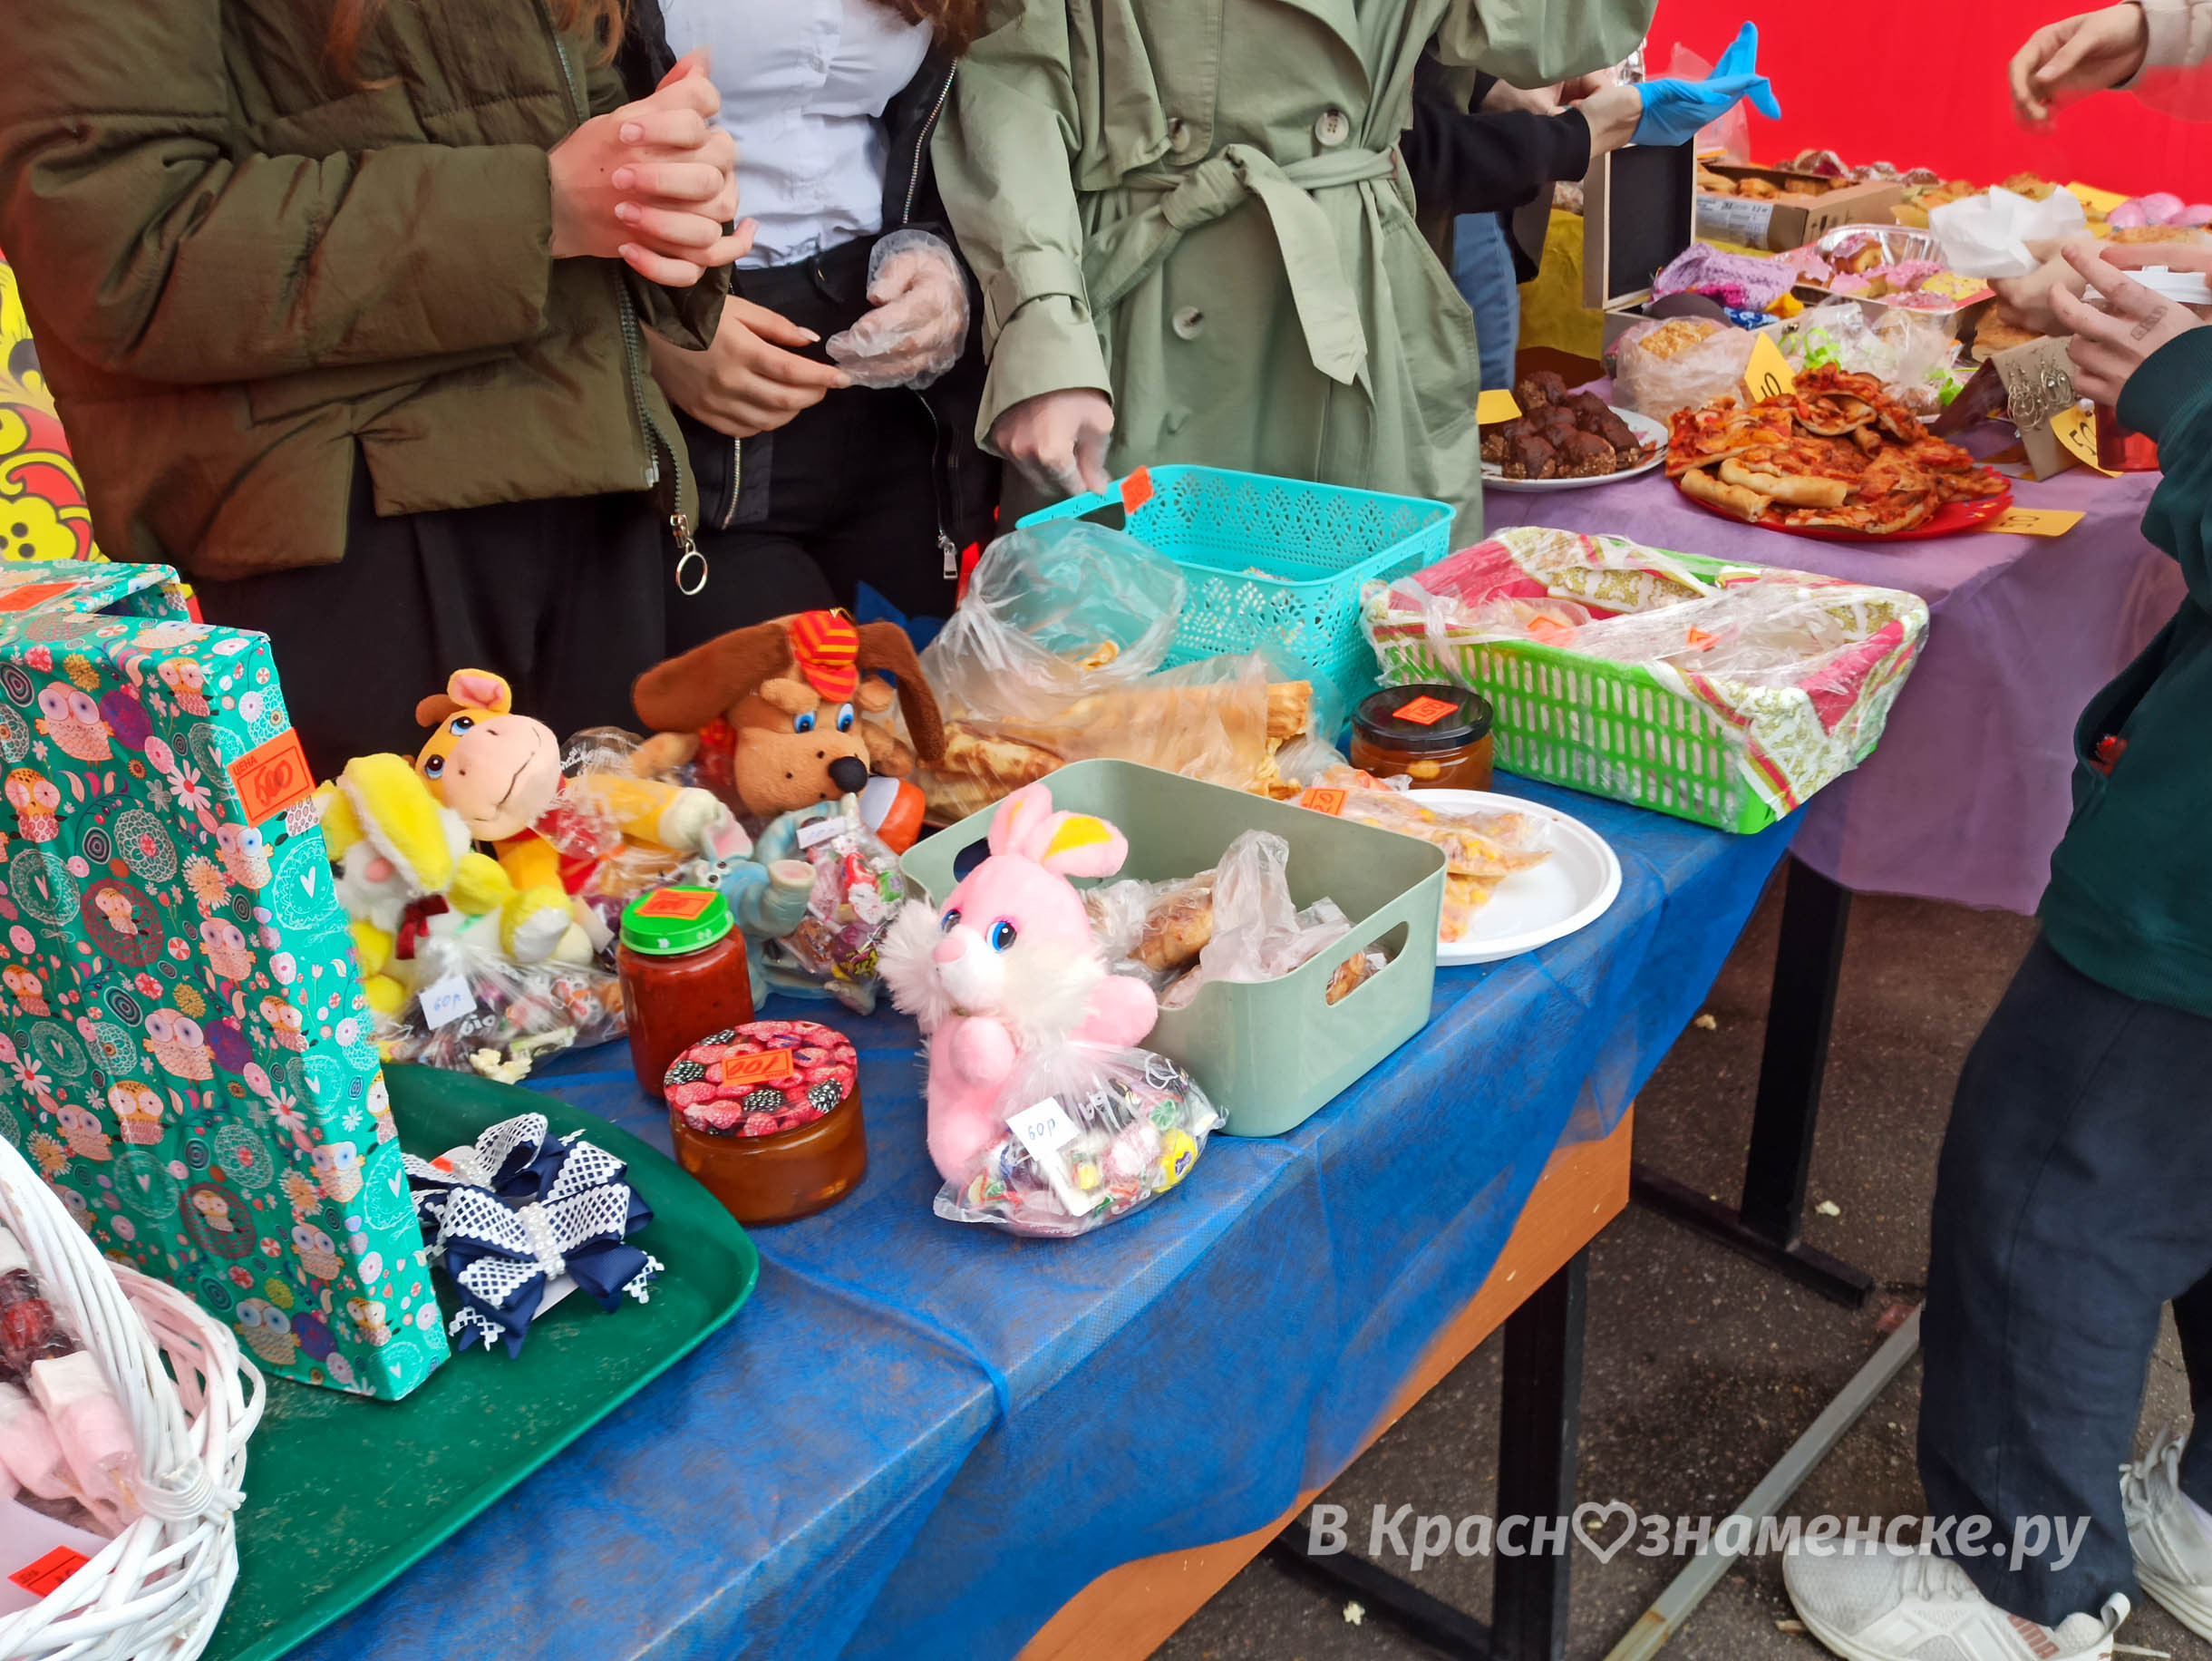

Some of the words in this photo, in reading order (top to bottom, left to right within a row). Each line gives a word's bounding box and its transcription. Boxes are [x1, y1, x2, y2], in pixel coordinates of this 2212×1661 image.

[2069, 422, 2097, 456] 50
[232, 755, 258, 777] ЦЕНА
[729, 1055, 779, 1077] 100
